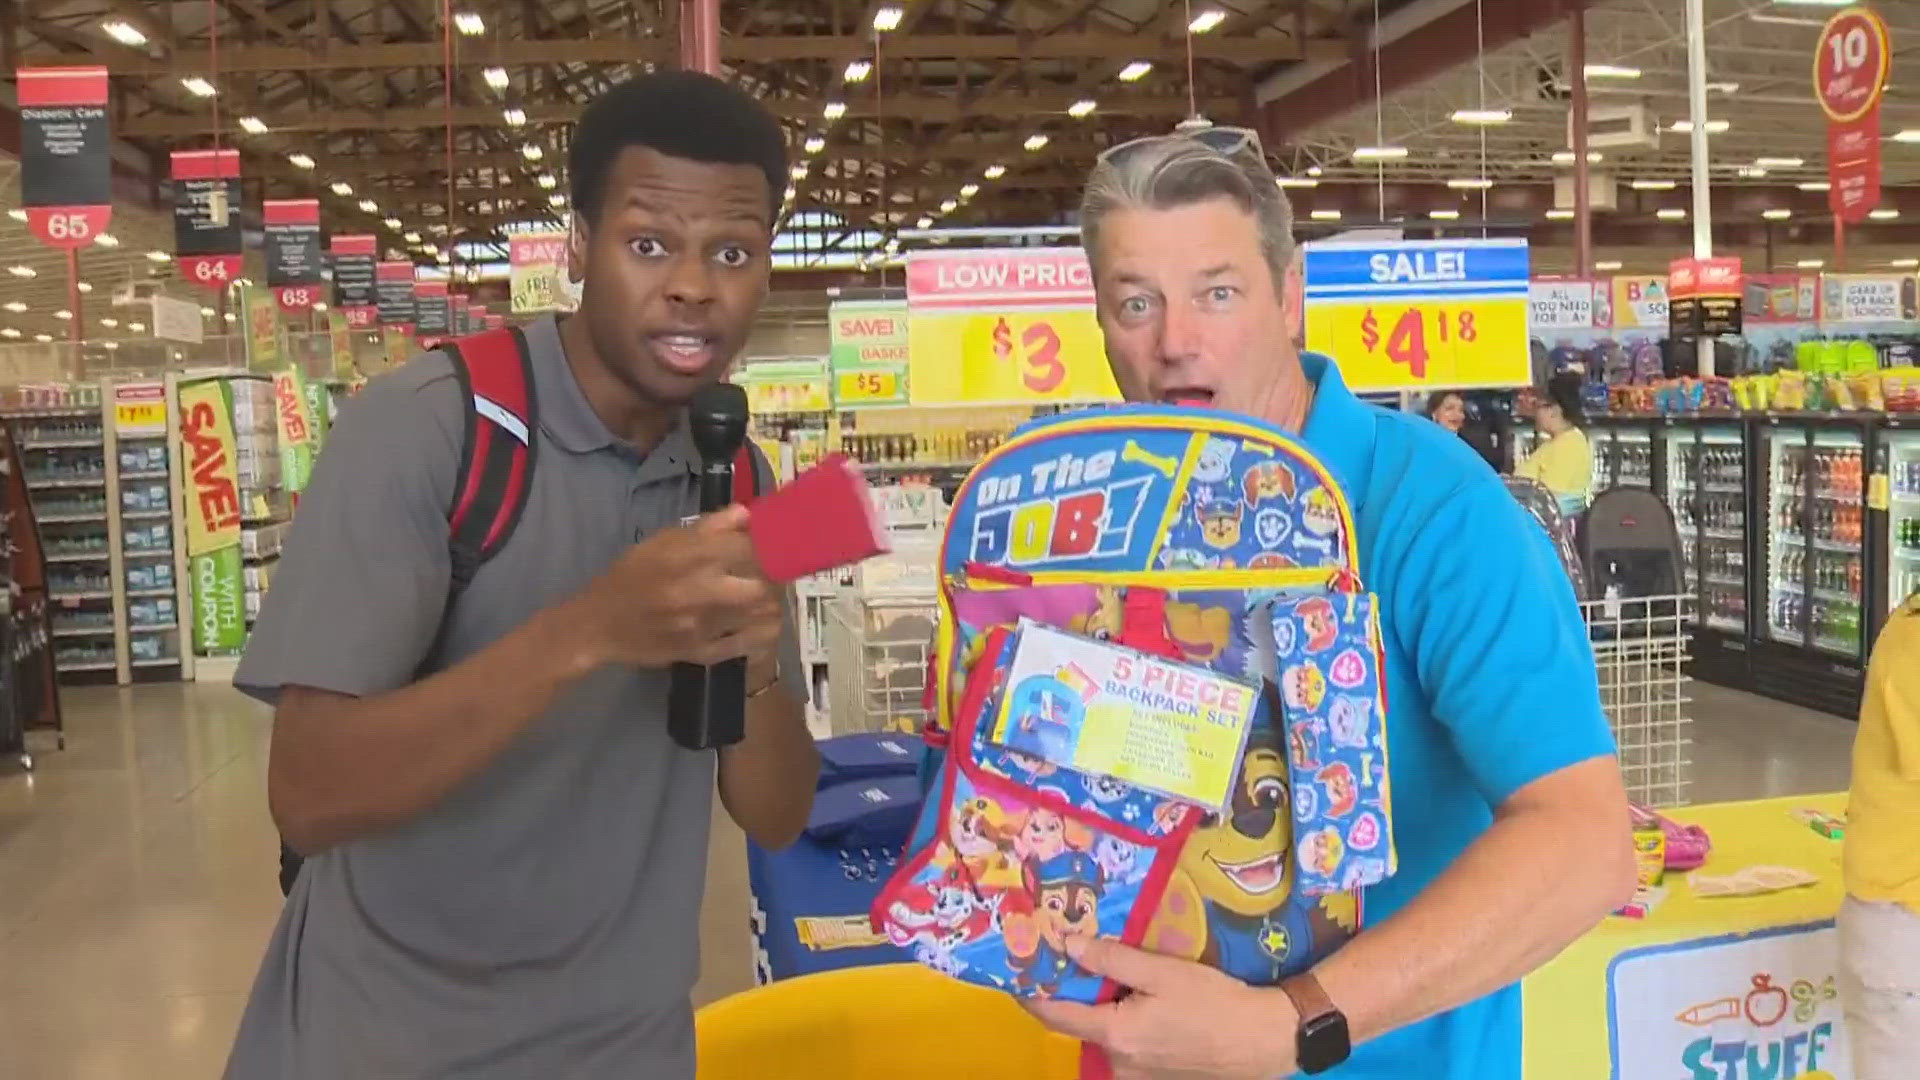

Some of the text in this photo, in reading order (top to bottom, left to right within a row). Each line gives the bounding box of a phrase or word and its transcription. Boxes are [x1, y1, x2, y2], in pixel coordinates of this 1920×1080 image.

[1828, 27, 1868, 73] 10
[47, 214, 90, 239] 65
[195, 260, 228, 281] 64
[937, 259, 1094, 289] LOW PRIC
[1369, 252, 1466, 282] SALE!
[282, 288, 309, 306] 63
[861, 346, 909, 361] BASKE
[993, 317, 1066, 393] $3
[857, 373, 882, 395] $5
[179, 401, 241, 533] SAVE!
[977, 450, 1117, 507] On The
[198, 557, 219, 648] COUPON
[220, 577, 236, 630] WITH
[1104, 679, 1240, 730] BACKPACK SET
[1112, 655, 1243, 713] 5 PIECE
